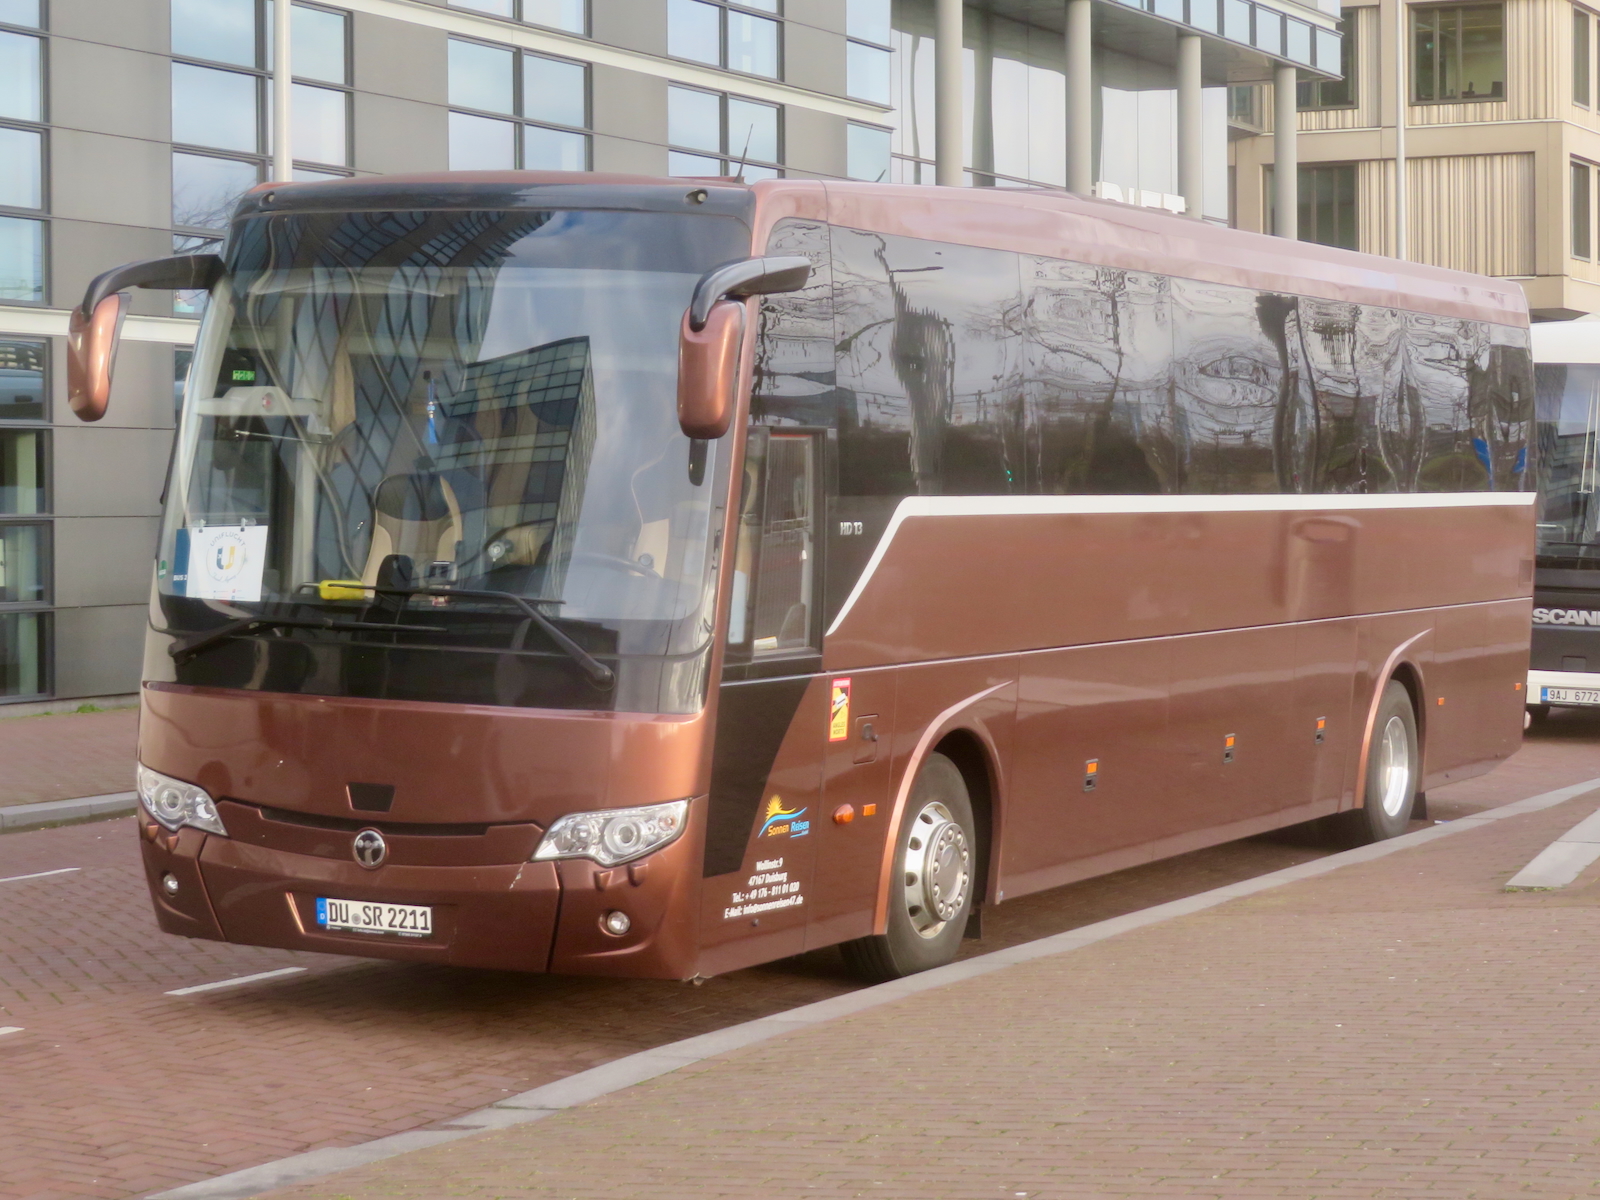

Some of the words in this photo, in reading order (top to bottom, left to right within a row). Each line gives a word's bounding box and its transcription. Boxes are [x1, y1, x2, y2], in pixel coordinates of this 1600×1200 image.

[840, 521, 852, 535] HD
[853, 521, 863, 535] 13
[1549, 690, 1567, 701] 9AJ
[1574, 691, 1599, 702] 6772
[768, 824, 789, 837] Sonnen
[790, 820, 810, 832] Reisen
[748, 873, 765, 886] 47167
[765, 871, 788, 884] Duisburg
[328, 901, 349, 923] DU
[362, 905, 383, 927] SR
[388, 907, 430, 931] 2211
